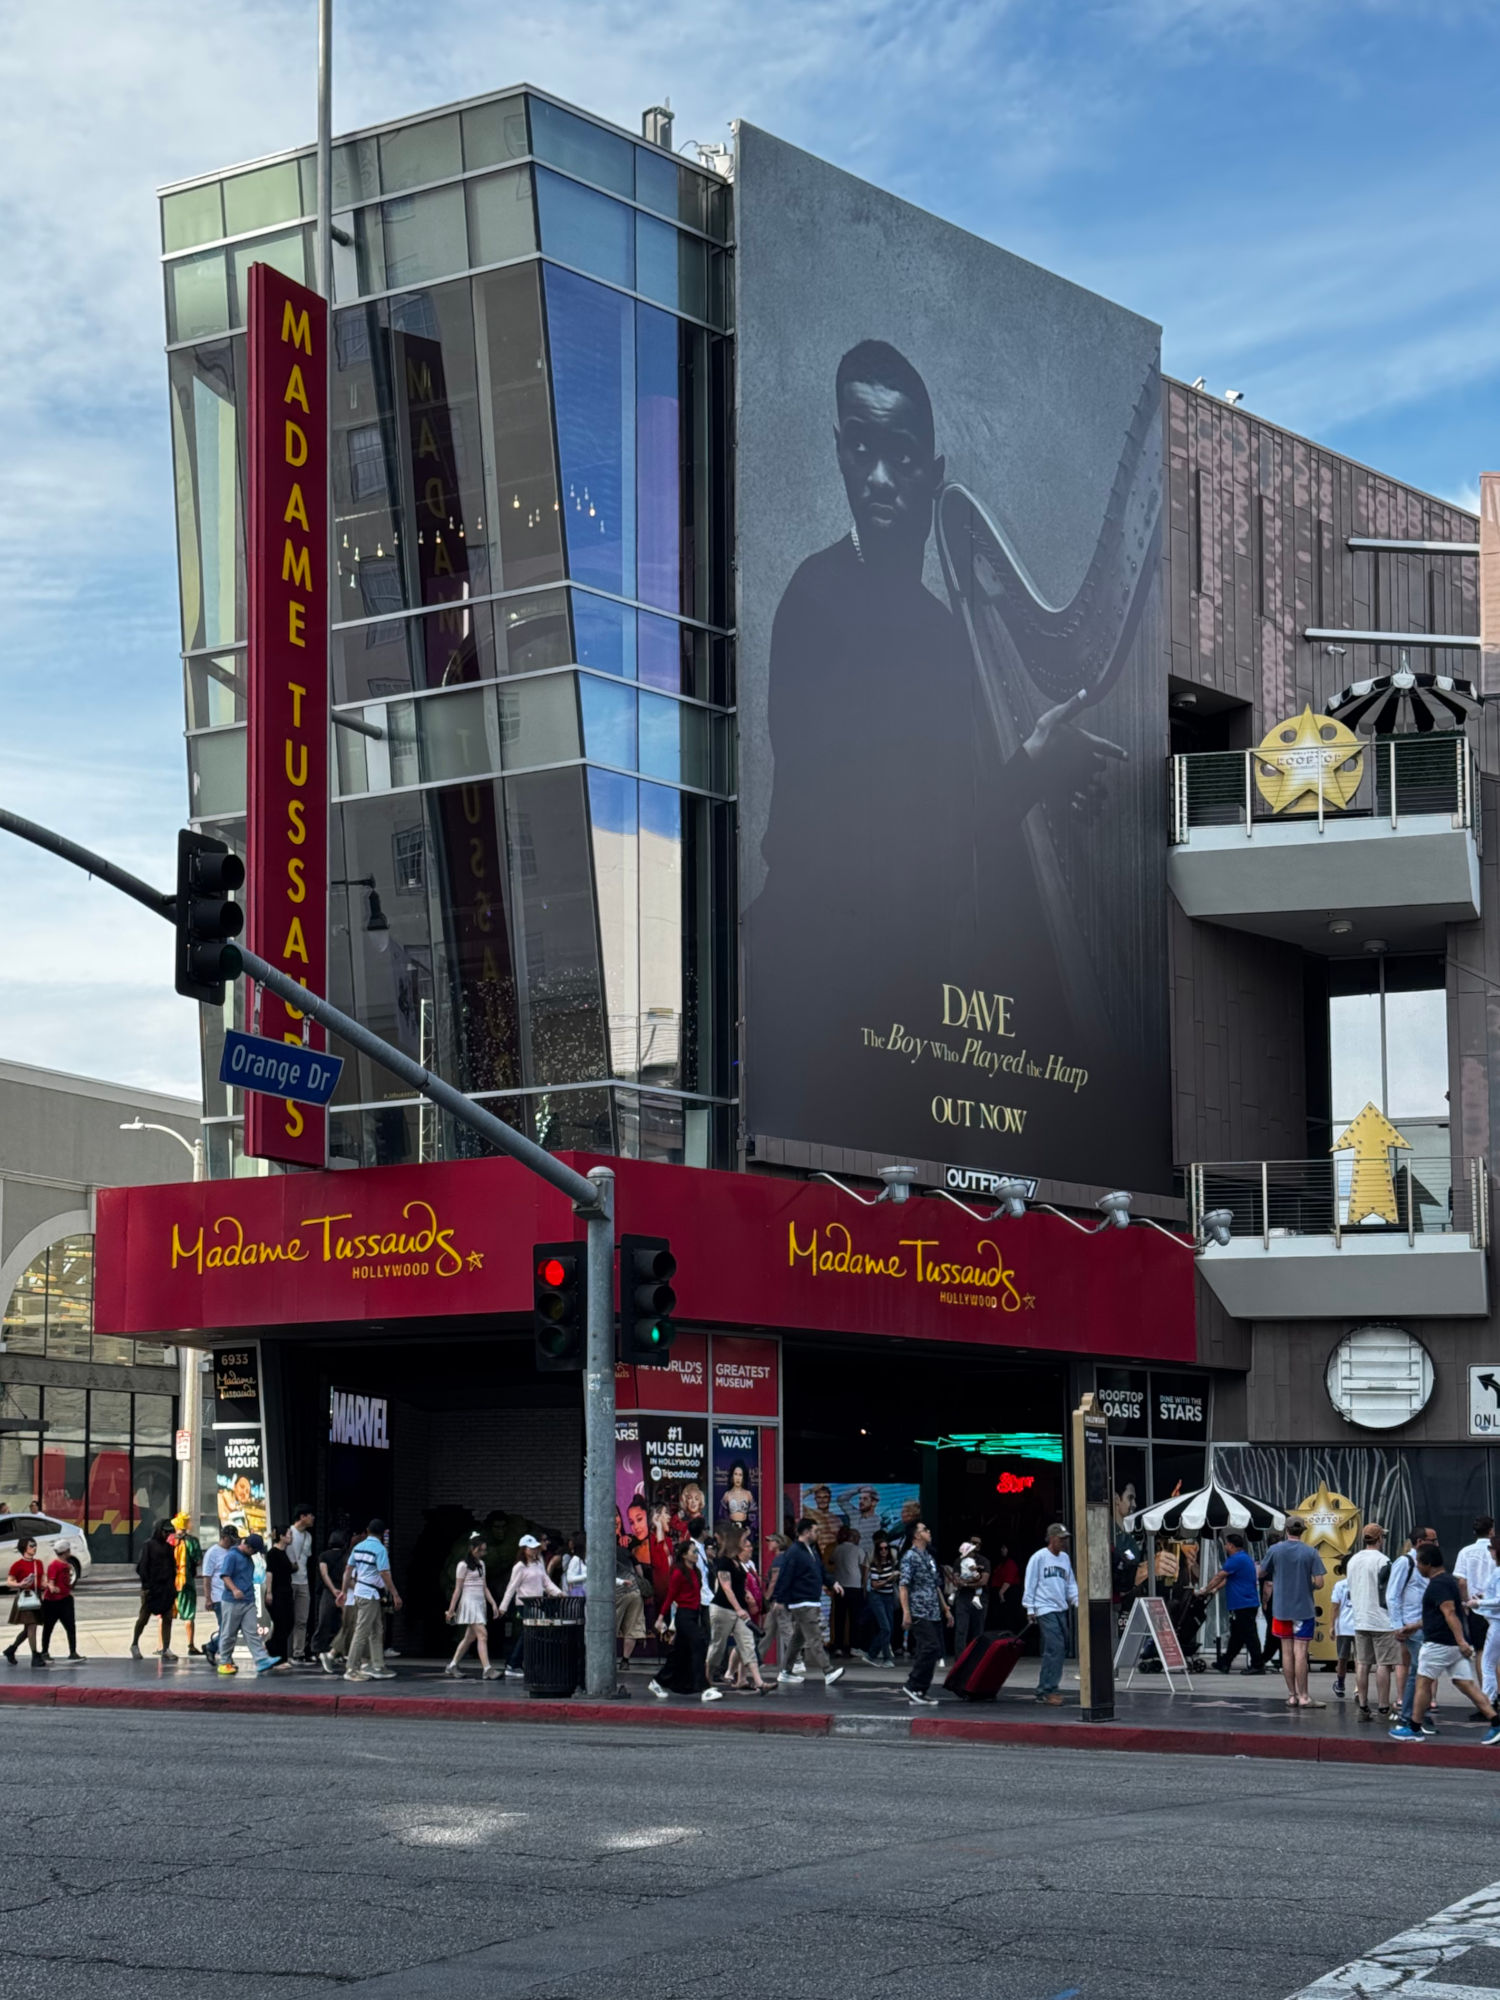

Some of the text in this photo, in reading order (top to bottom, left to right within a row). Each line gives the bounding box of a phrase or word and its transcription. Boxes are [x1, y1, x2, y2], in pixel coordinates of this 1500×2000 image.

[281, 300, 313, 1138] MADAME TUSSAS
[942, 983, 1016, 1037] DAVE
[861, 1023, 1089, 1093] The Boy Who Played the Harp
[231, 1044, 331, 1091] Orange Dr
[931, 1095, 1028, 1134] OUT NOW
[172, 1201, 462, 1277] Madame Tussauds
[352, 1262, 430, 1279] HOLLYWOOD
[789, 1221, 1021, 1312] Madame Tussauds
[940, 1291, 998, 1309] HOLLYWOOD
[221, 1353, 249, 1366] 6933
[216, 1370, 257, 1386] Madame
[681, 1373, 703, 1385] WAX
[715, 1363, 770, 1379] GREATEST
[715, 1377, 754, 1389] MUSEUM
[217, 1384, 257, 1400] Tussauds
[1099, 1389, 1144, 1403] ROOFTOP
[1159, 1395, 1202, 1405] DINE WITH THE
[1103, 1402, 1141, 1419] OASIS
[1160, 1403, 1203, 1422] STARS
[332, 1391, 390, 1449] MARVEL
[667, 1426, 683, 1441] #1
[646, 1441, 704, 1458] MUSEUM
[721, 1435, 752, 1449] WAX!
[224, 1445, 261, 1457] HAPPY
[227, 1456, 259, 1468] HOUR
[659, 1458, 701, 1467] HOLLYWOOD
[662, 1468, 699, 1479] Tripadvisor
